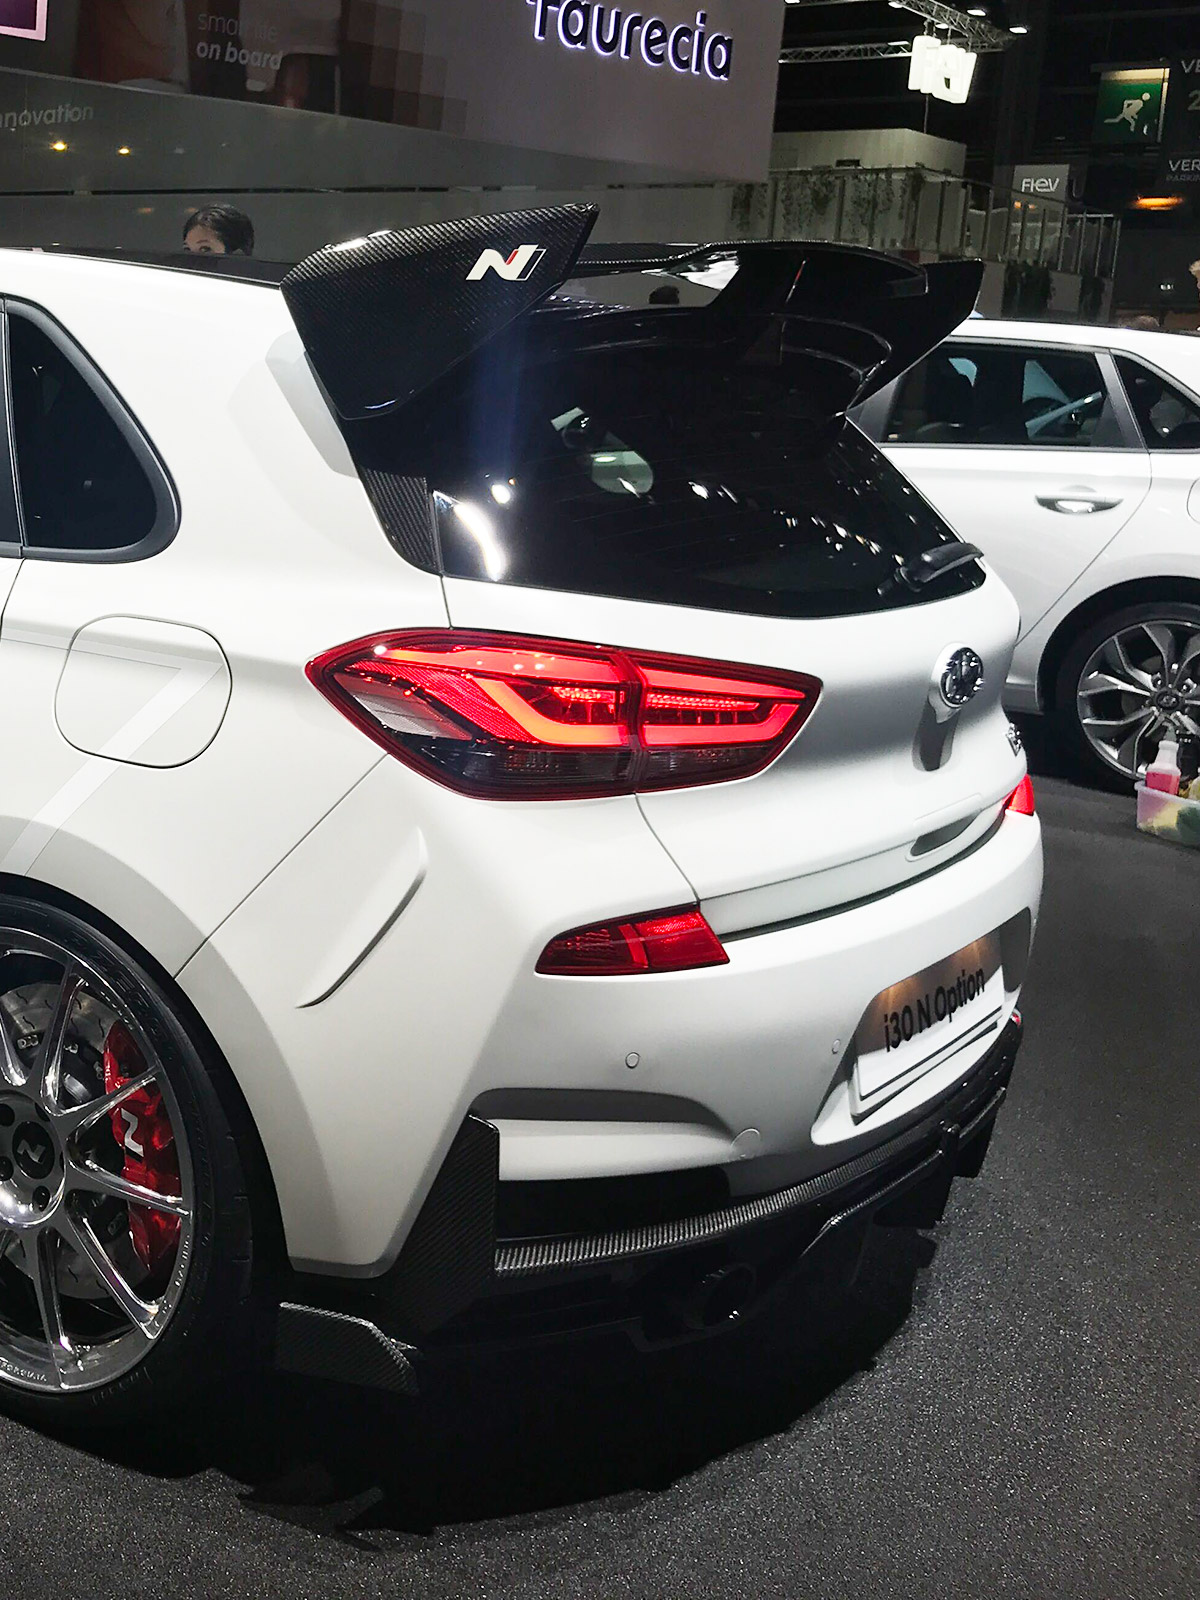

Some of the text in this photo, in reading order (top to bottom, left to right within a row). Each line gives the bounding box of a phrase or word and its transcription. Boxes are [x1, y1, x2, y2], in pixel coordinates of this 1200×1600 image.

[196, 41, 283, 70] on board
[884, 968, 985, 1053] i30 N Option
